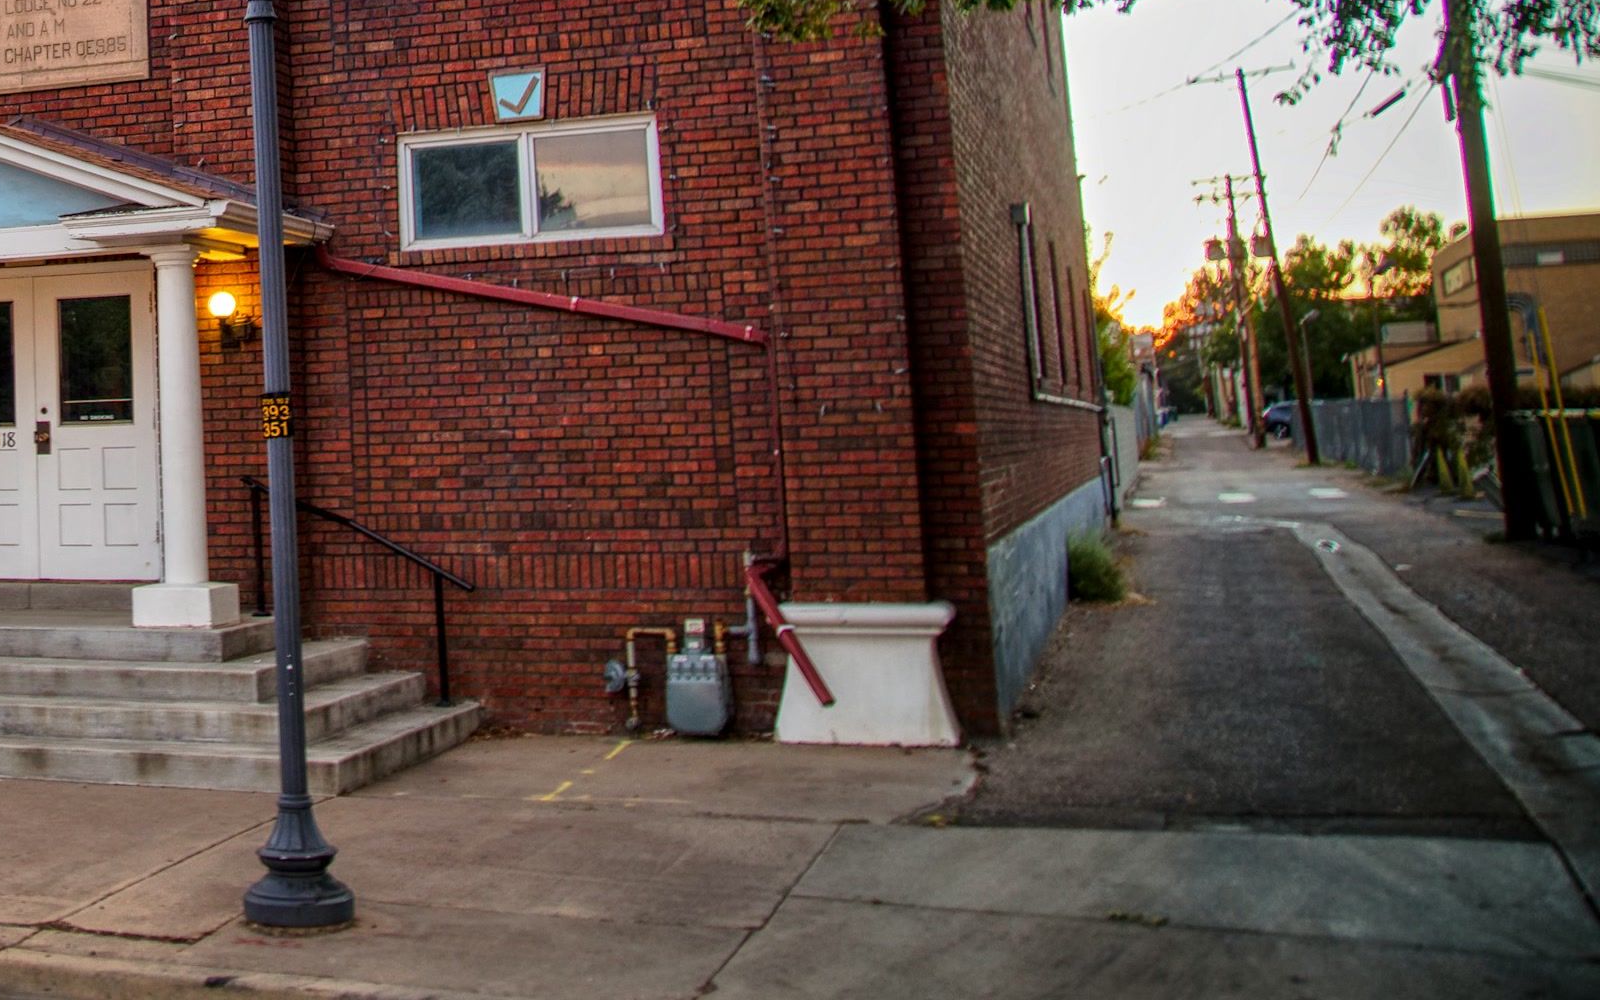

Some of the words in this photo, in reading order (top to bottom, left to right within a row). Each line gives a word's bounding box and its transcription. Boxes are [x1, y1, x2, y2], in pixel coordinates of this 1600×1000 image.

[7, 21, 35, 40] AND
[40, 20, 49, 38] A
[54, 18, 66, 35] M
[3, 42, 72, 66] CHAPTER
[262, 404, 289, 421] 393
[263, 421, 289, 437] 351
[2, 432, 16, 448] 18
